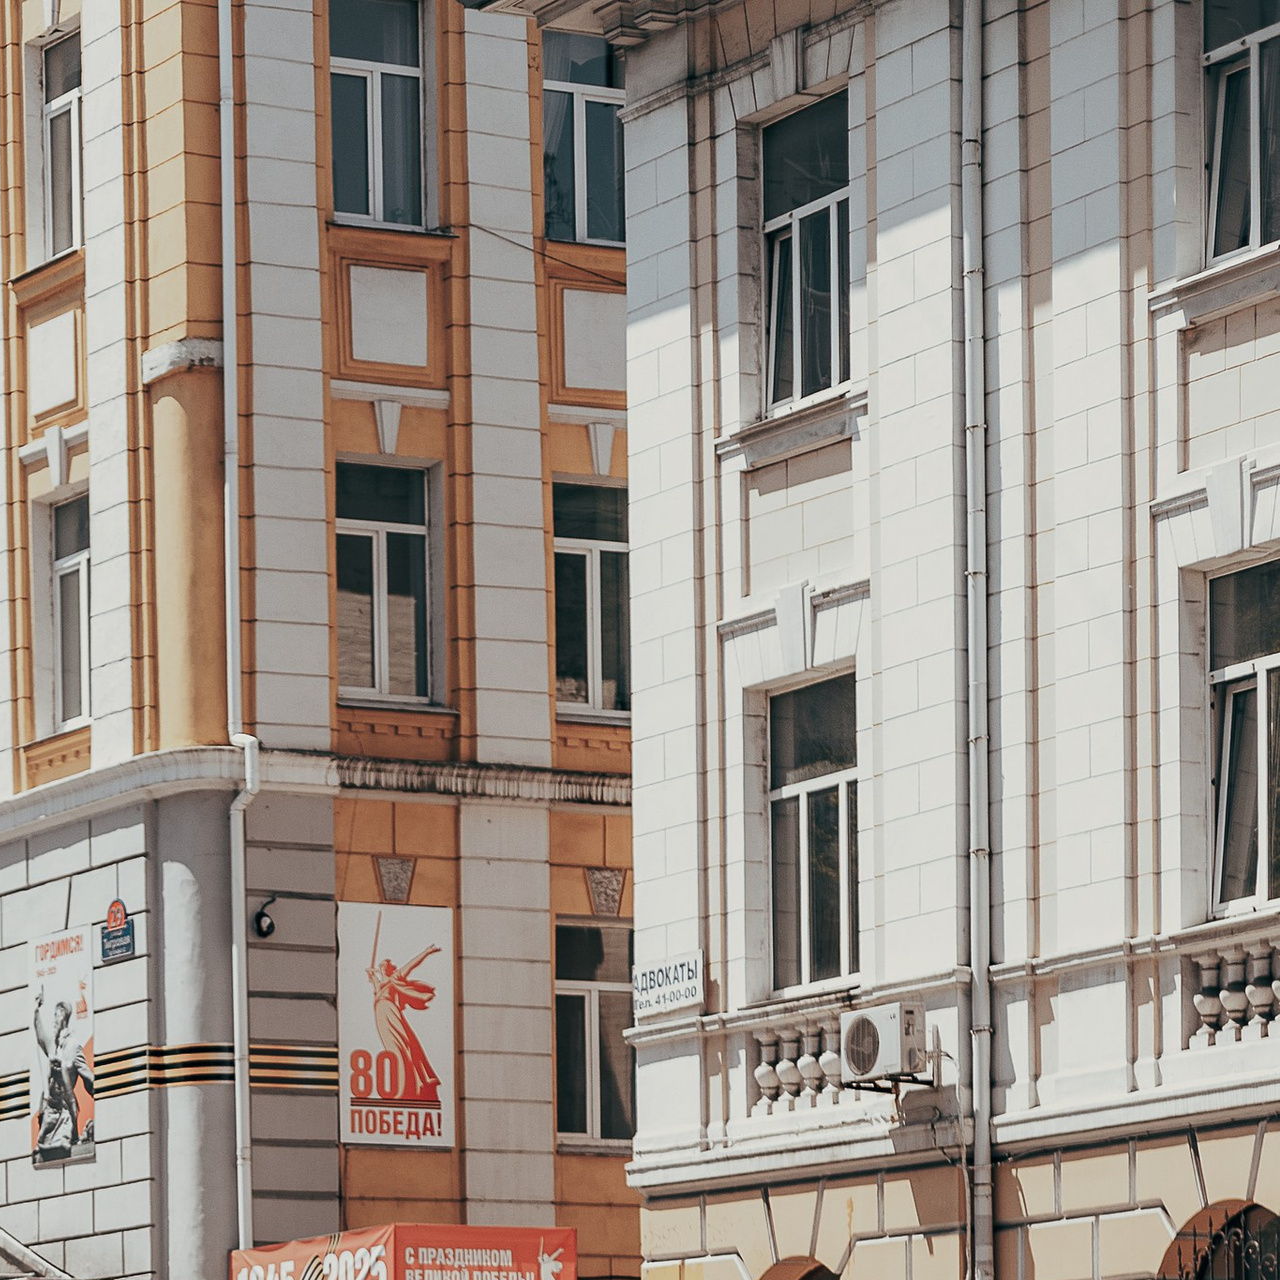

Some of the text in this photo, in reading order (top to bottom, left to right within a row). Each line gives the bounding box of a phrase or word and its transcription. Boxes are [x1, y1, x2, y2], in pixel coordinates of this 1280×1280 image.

[35, 934, 83, 962] ГОРДИМСЯ!
[634, 959, 698, 996] АДВОКАТЫ
[655, 985, 697, 1005] 41-00-00
[350, 1049, 399, 1099] 80
[350, 1109, 442, 1140] ПОБЕДА!
[405, 1247, 512, 1268] С ПРАЗДНИКОМ
